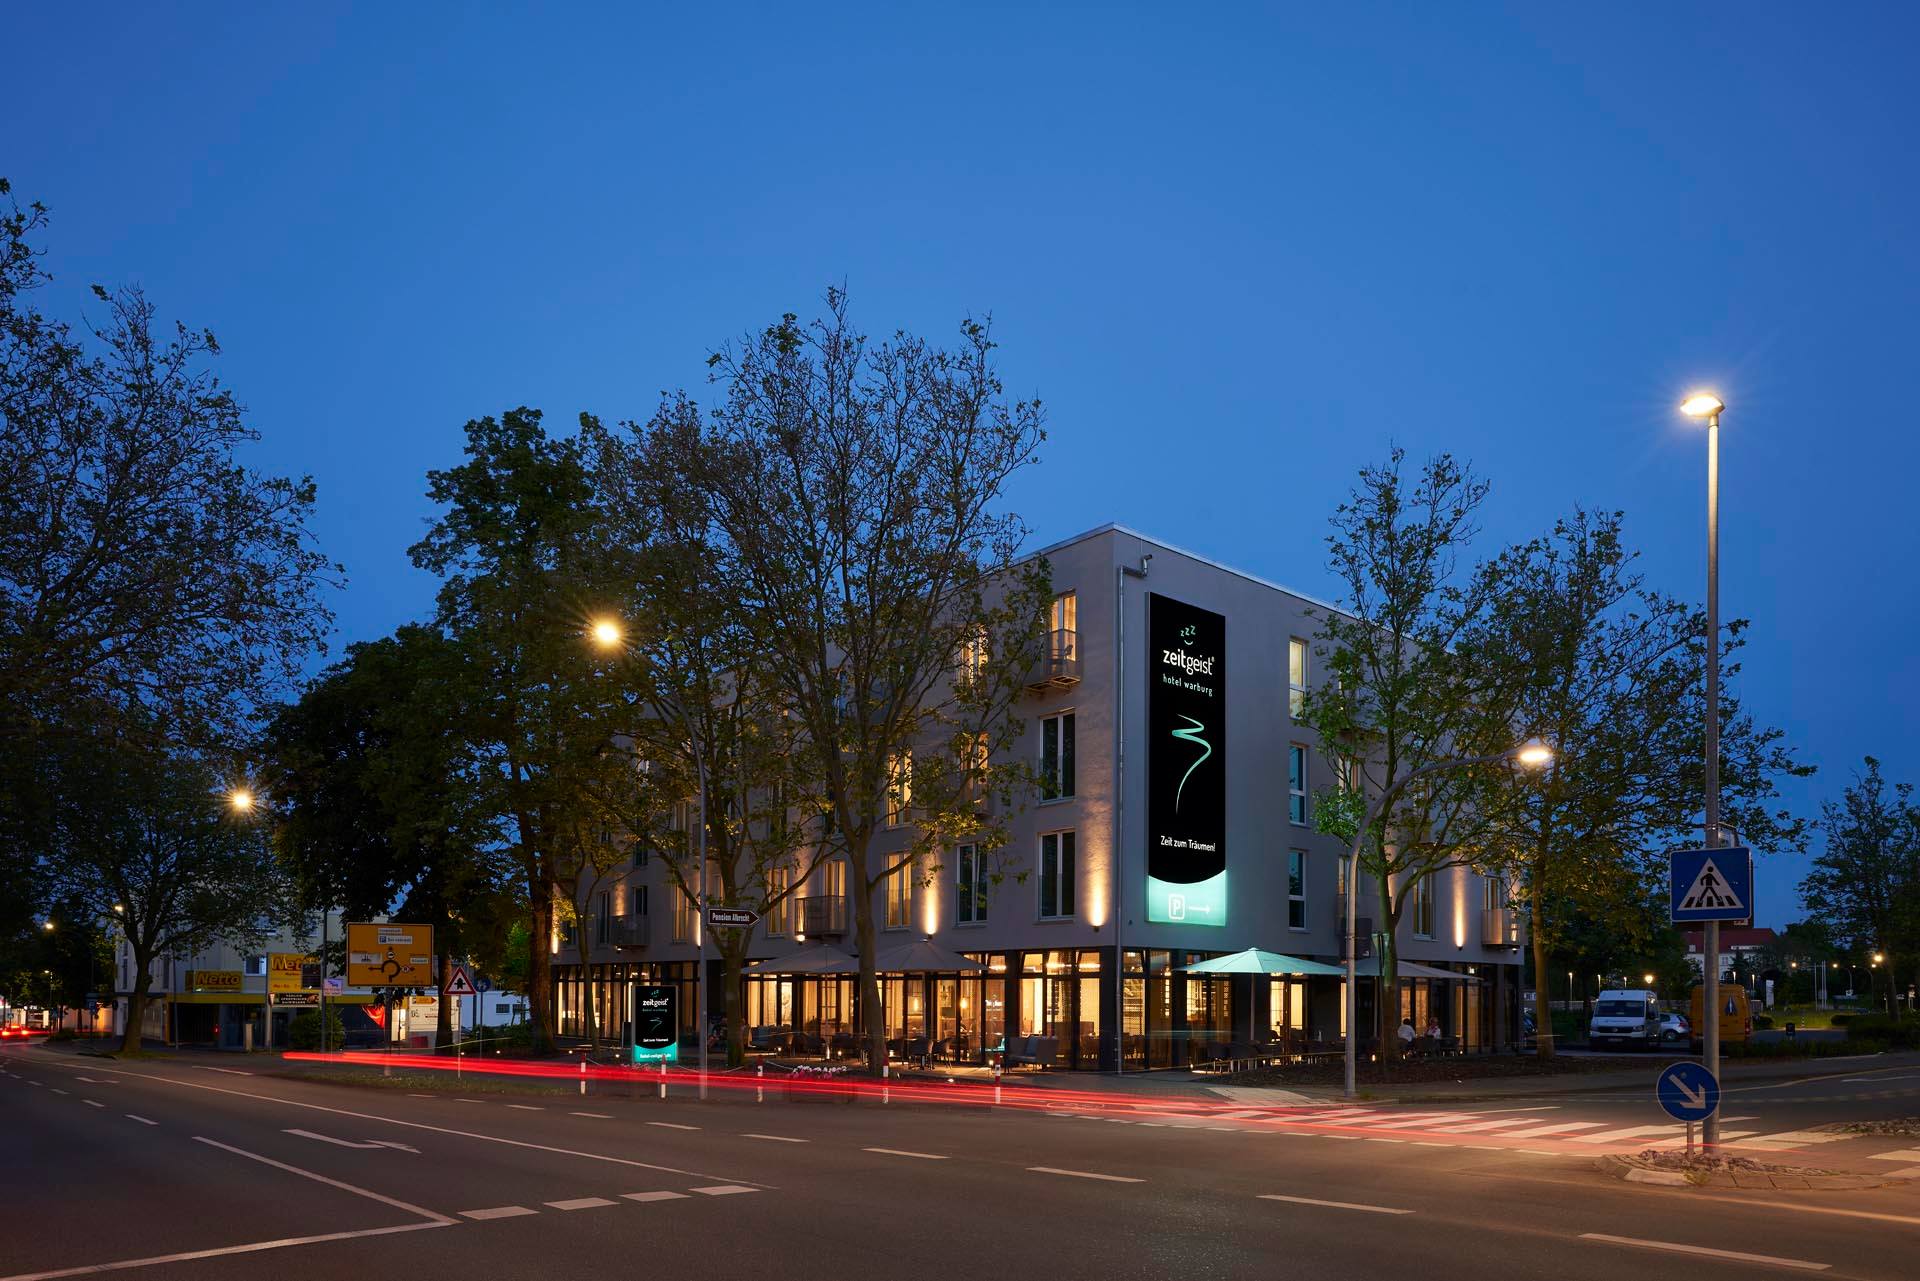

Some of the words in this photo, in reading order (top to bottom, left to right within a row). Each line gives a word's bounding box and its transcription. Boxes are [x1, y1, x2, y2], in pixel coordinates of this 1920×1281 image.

[1162, 673, 1182, 687] hotel
[1183, 682, 1213, 697] warburg
[1160, 835, 1173, 847] Zeit
[1173, 839, 1187, 848] zum
[1188, 839, 1216, 852] Träumen!
[712, 912, 731, 921] Pension
[196, 973, 241, 986] Netto
